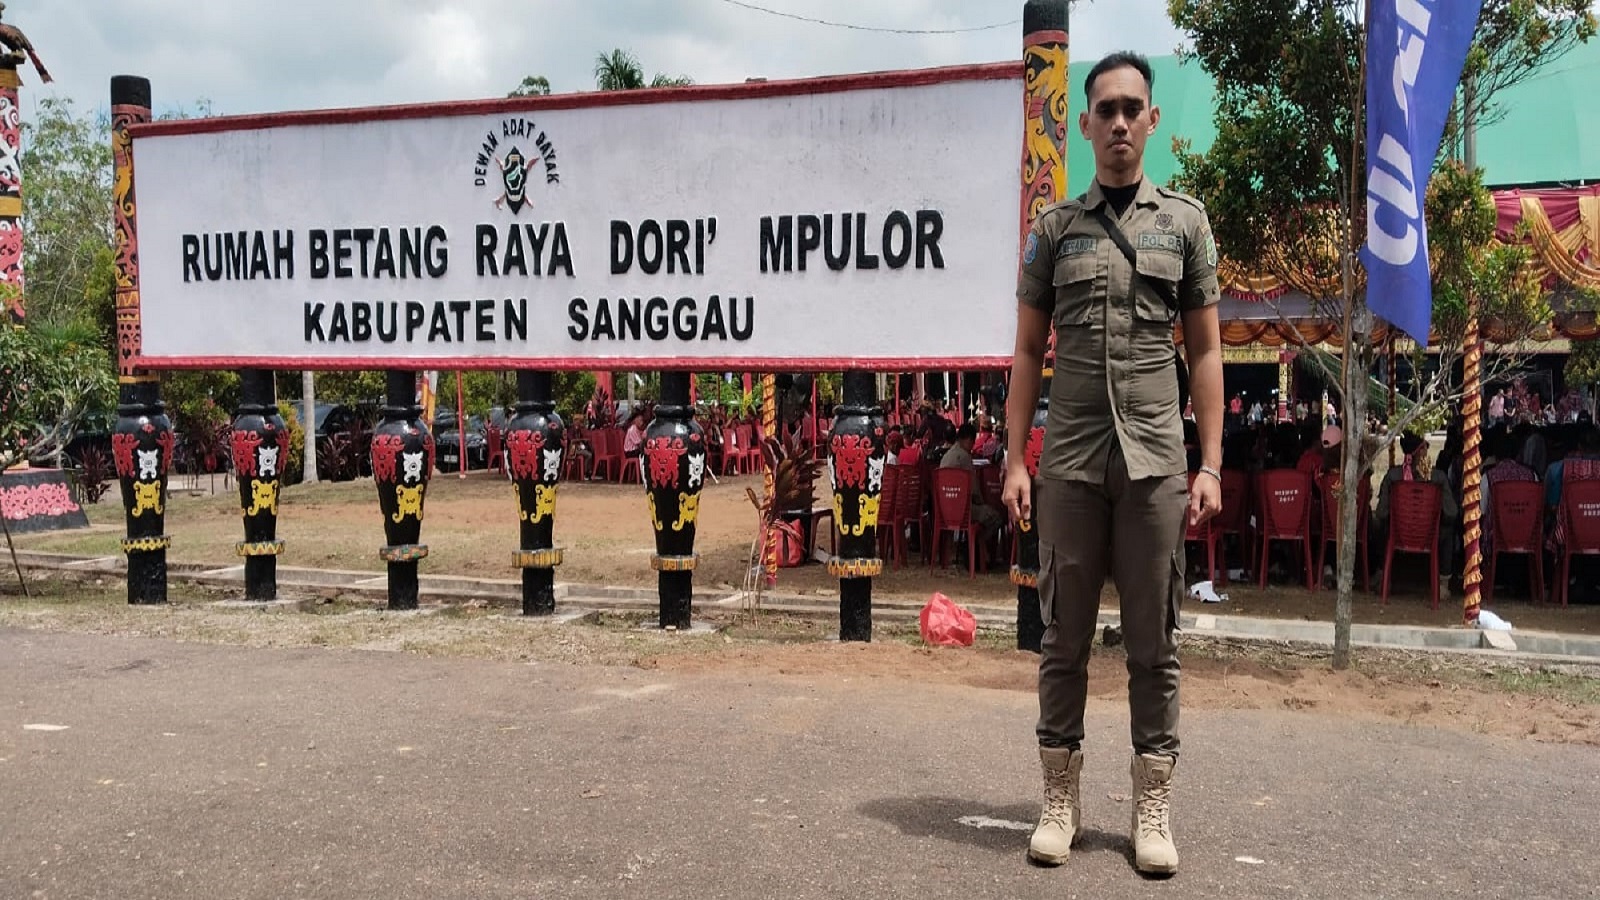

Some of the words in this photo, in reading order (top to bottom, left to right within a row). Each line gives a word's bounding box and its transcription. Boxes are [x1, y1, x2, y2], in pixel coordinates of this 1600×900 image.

[474, 130, 499, 187] DEWAN
[502, 118, 536, 139] ADAT
[535, 131, 560, 184] DAYAK
[182, 229, 294, 283] RUMAH
[309, 225, 448, 279] BETANG
[475, 222, 574, 277] RAYA
[610, 217, 717, 275] DORI'
[759, 209, 945, 274] MPULOR
[1141, 235, 1164, 247] POL
[304, 298, 528, 343] KABUPATEN
[567, 295, 754, 342] SANGGAU
